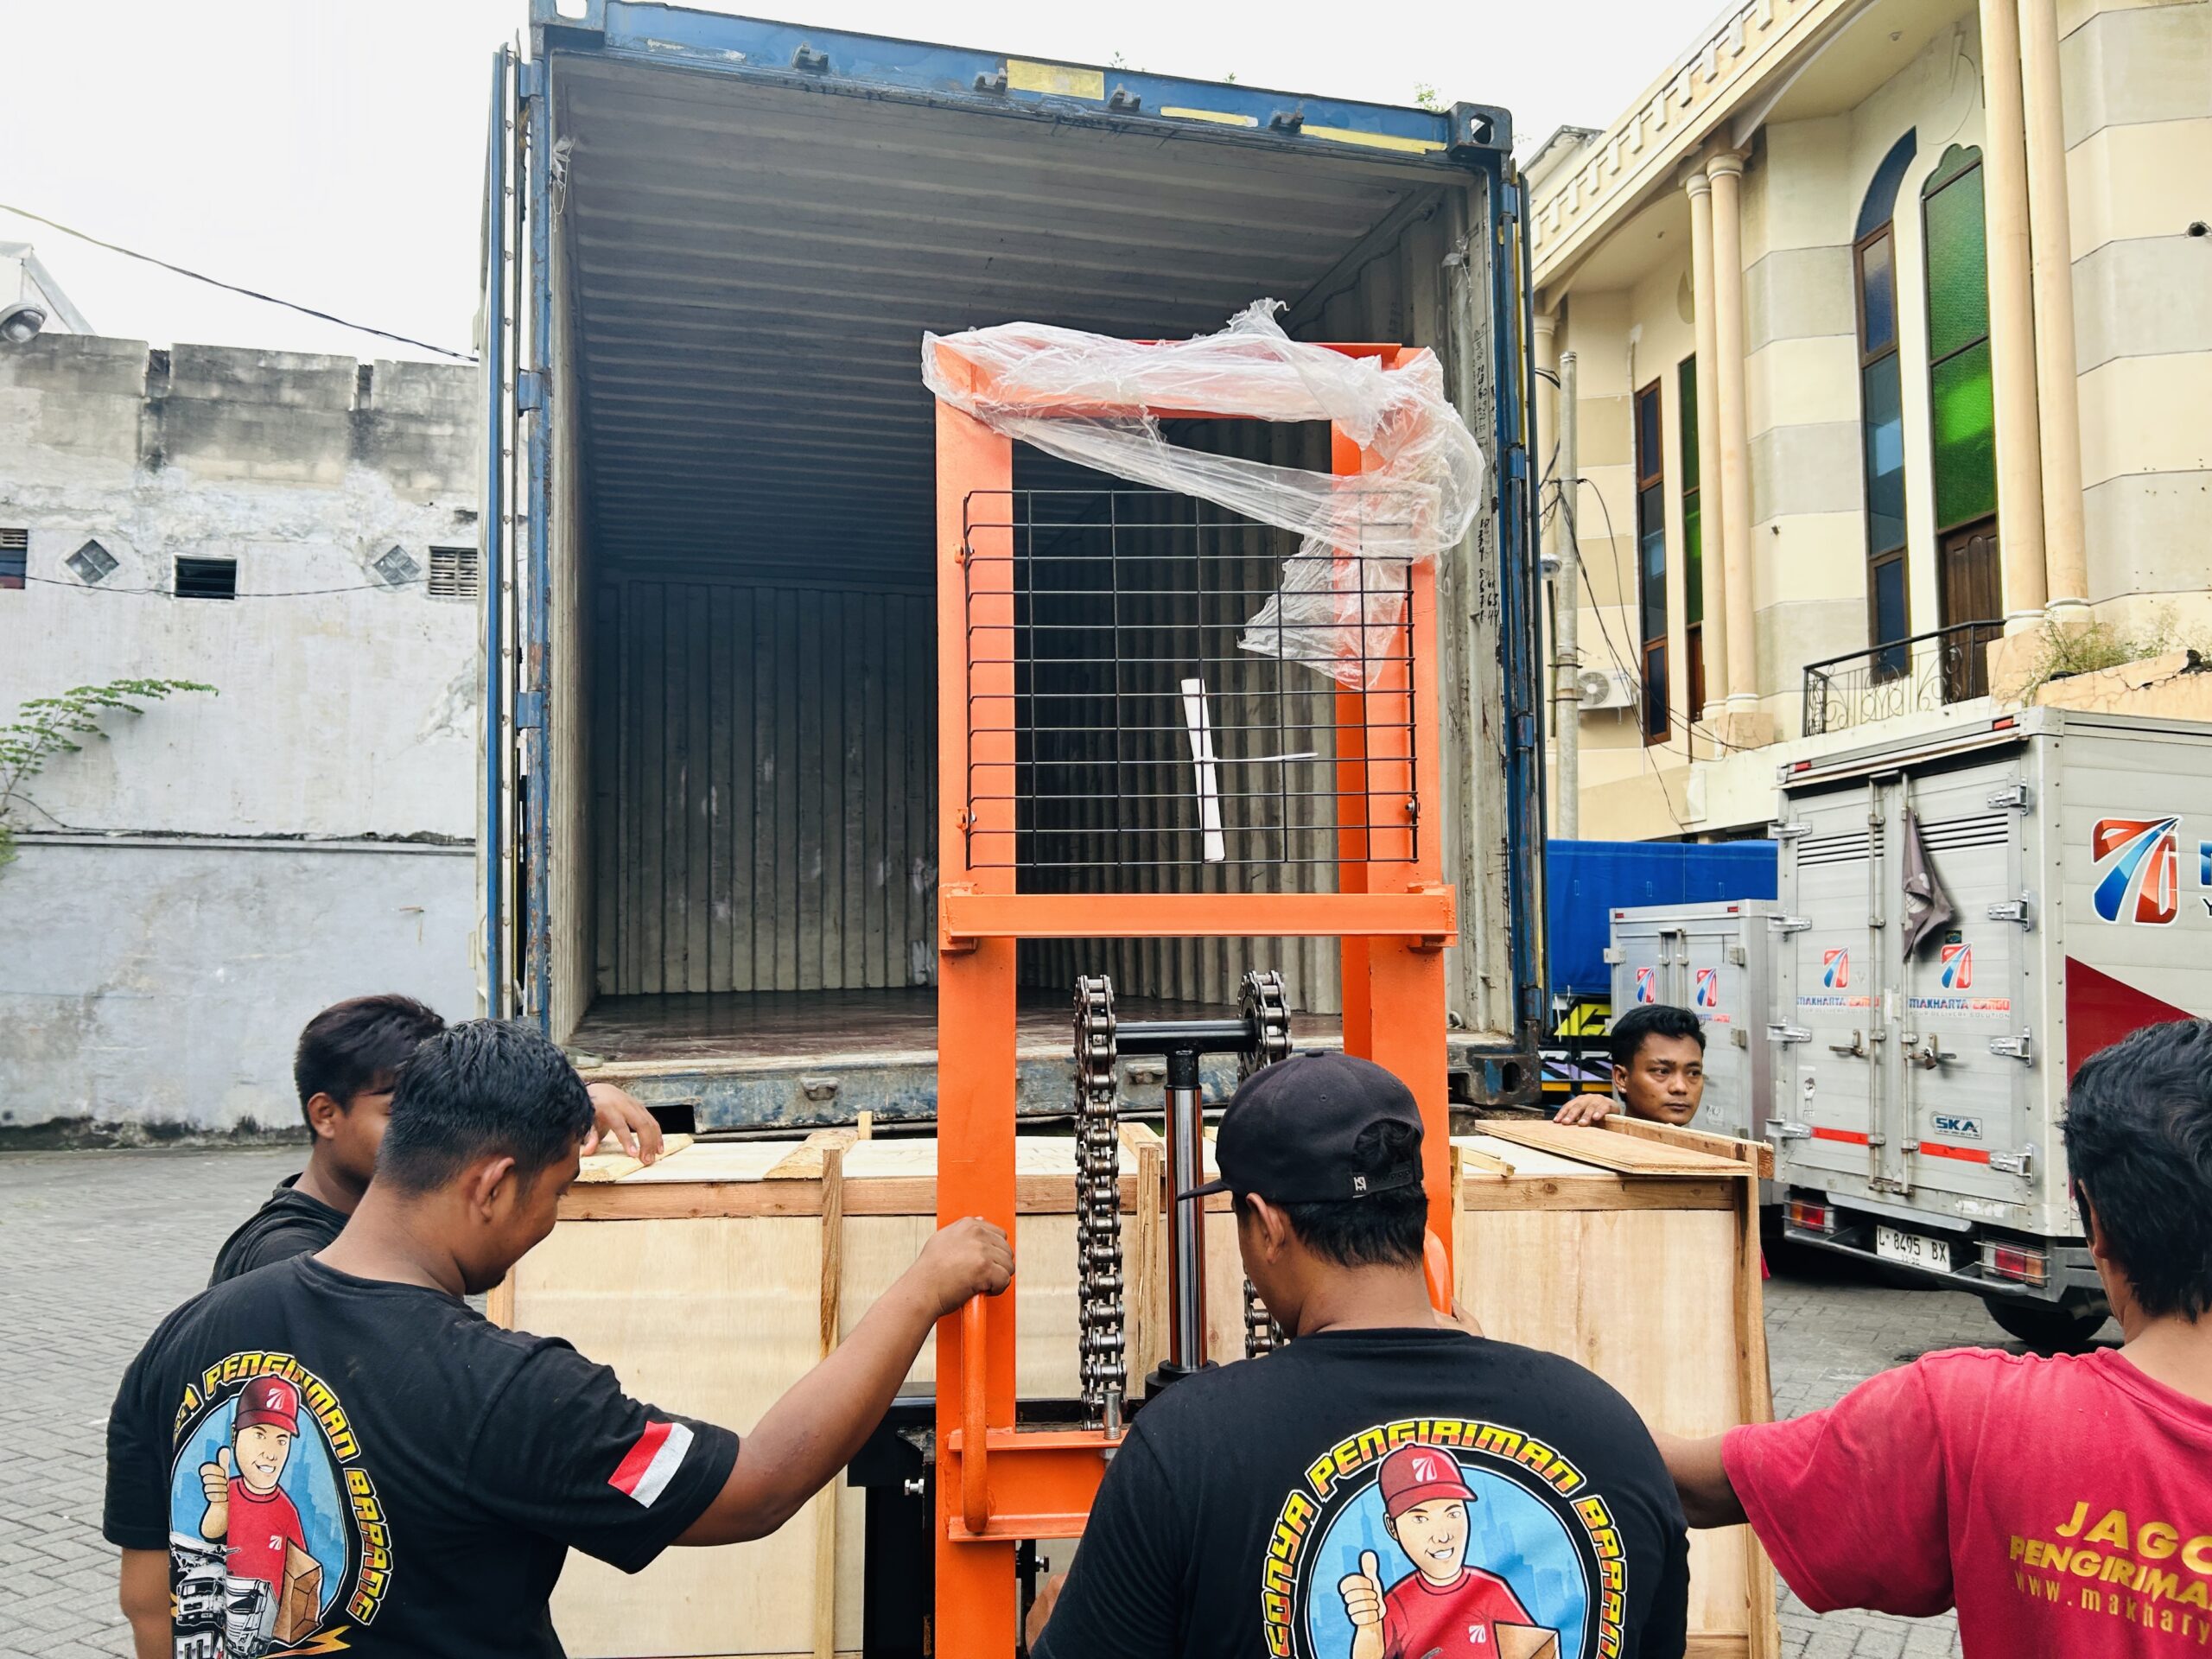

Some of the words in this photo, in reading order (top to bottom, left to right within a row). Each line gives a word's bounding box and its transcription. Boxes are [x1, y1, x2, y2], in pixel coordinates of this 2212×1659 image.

[1909, 998, 1968, 1010] MAKHARYA
[1936, 1117, 1979, 1134] SKA
[1878, 1227, 1885, 1246] L
[1893, 1232, 1921, 1255] 8495
[1931, 1241, 1947, 1262] BX
[346, 1469, 393, 1624] BARANG
[1306, 1418, 1585, 1501] PENGIRIMAN
[1569, 1495, 1628, 1659] BARAN
[2010, 1535, 2212, 1611] PENGIRIMA
